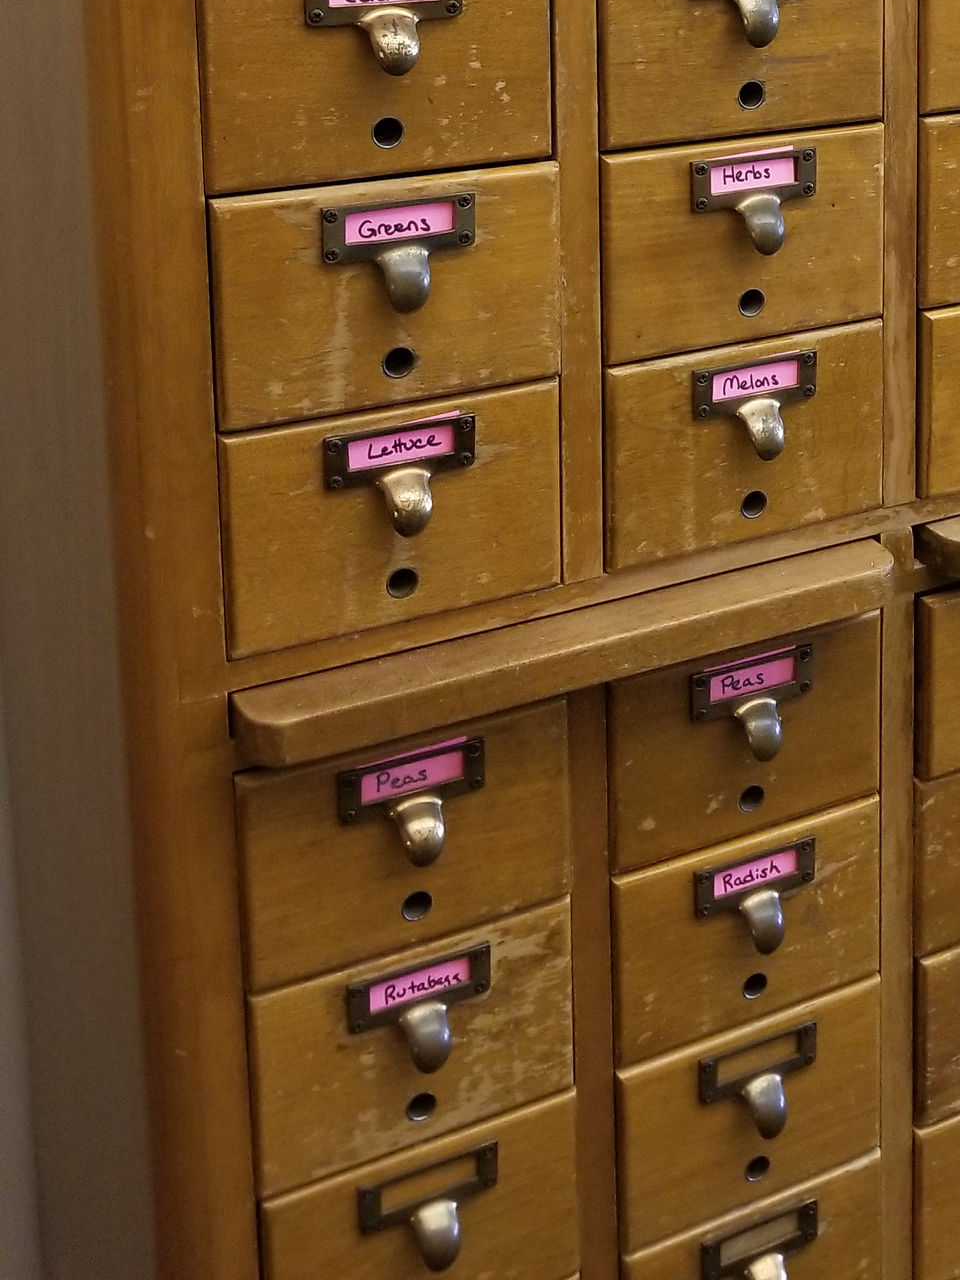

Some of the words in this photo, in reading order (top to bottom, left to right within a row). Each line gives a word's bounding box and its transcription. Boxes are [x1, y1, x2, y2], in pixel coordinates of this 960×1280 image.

[722, 165, 772, 186] Herbs
[358, 217, 432, 239] Greens
[722, 373, 780, 396] Melons
[368, 434, 443, 460] Lettuce
[721, 673, 765, 695] Peas
[376, 768, 427, 793] Peas
[722, 861, 780, 892] Radish
